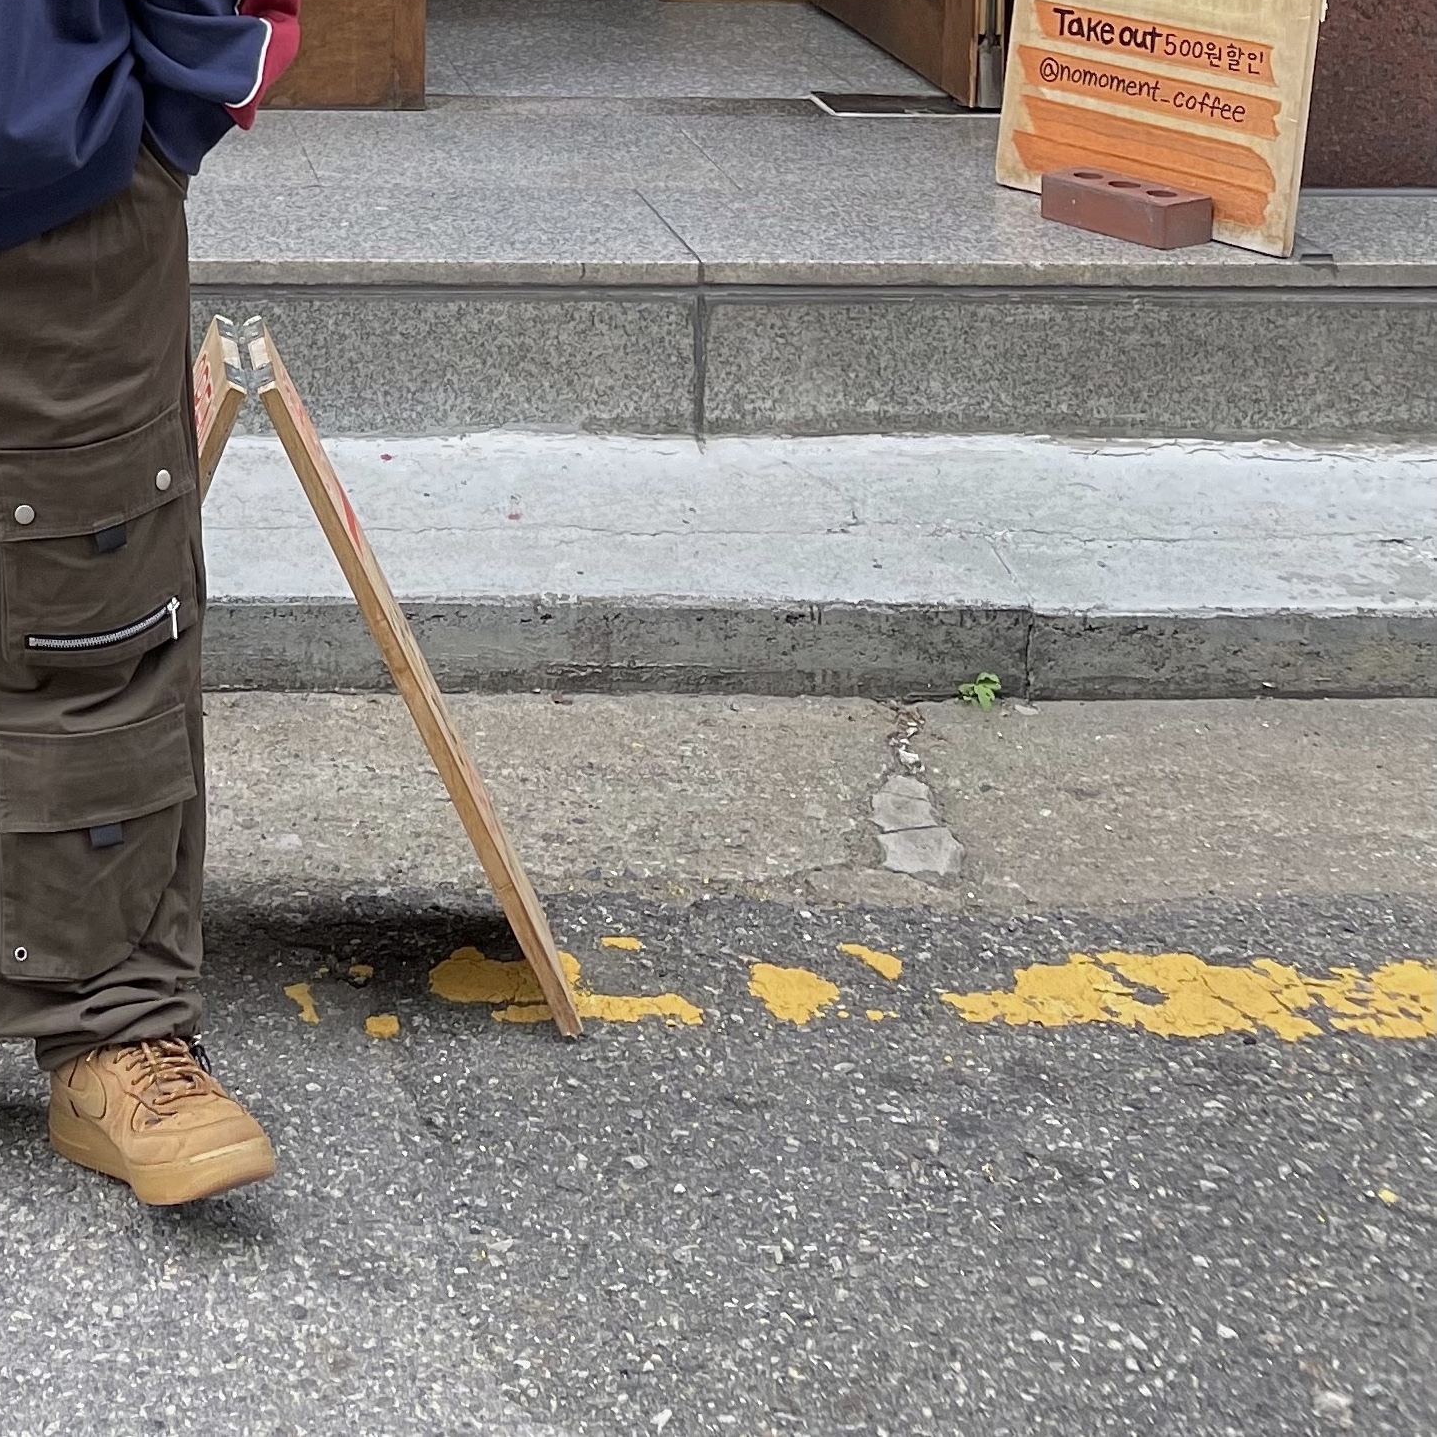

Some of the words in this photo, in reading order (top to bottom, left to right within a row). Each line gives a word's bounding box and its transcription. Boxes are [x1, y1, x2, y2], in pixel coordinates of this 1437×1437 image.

[1053, 7, 1115, 45] Take
[1119, 26, 1163, 54] out
[1226, 42, 1264, 76] 할인
[1039, 56, 1246, 123] @nomoment_coffee
